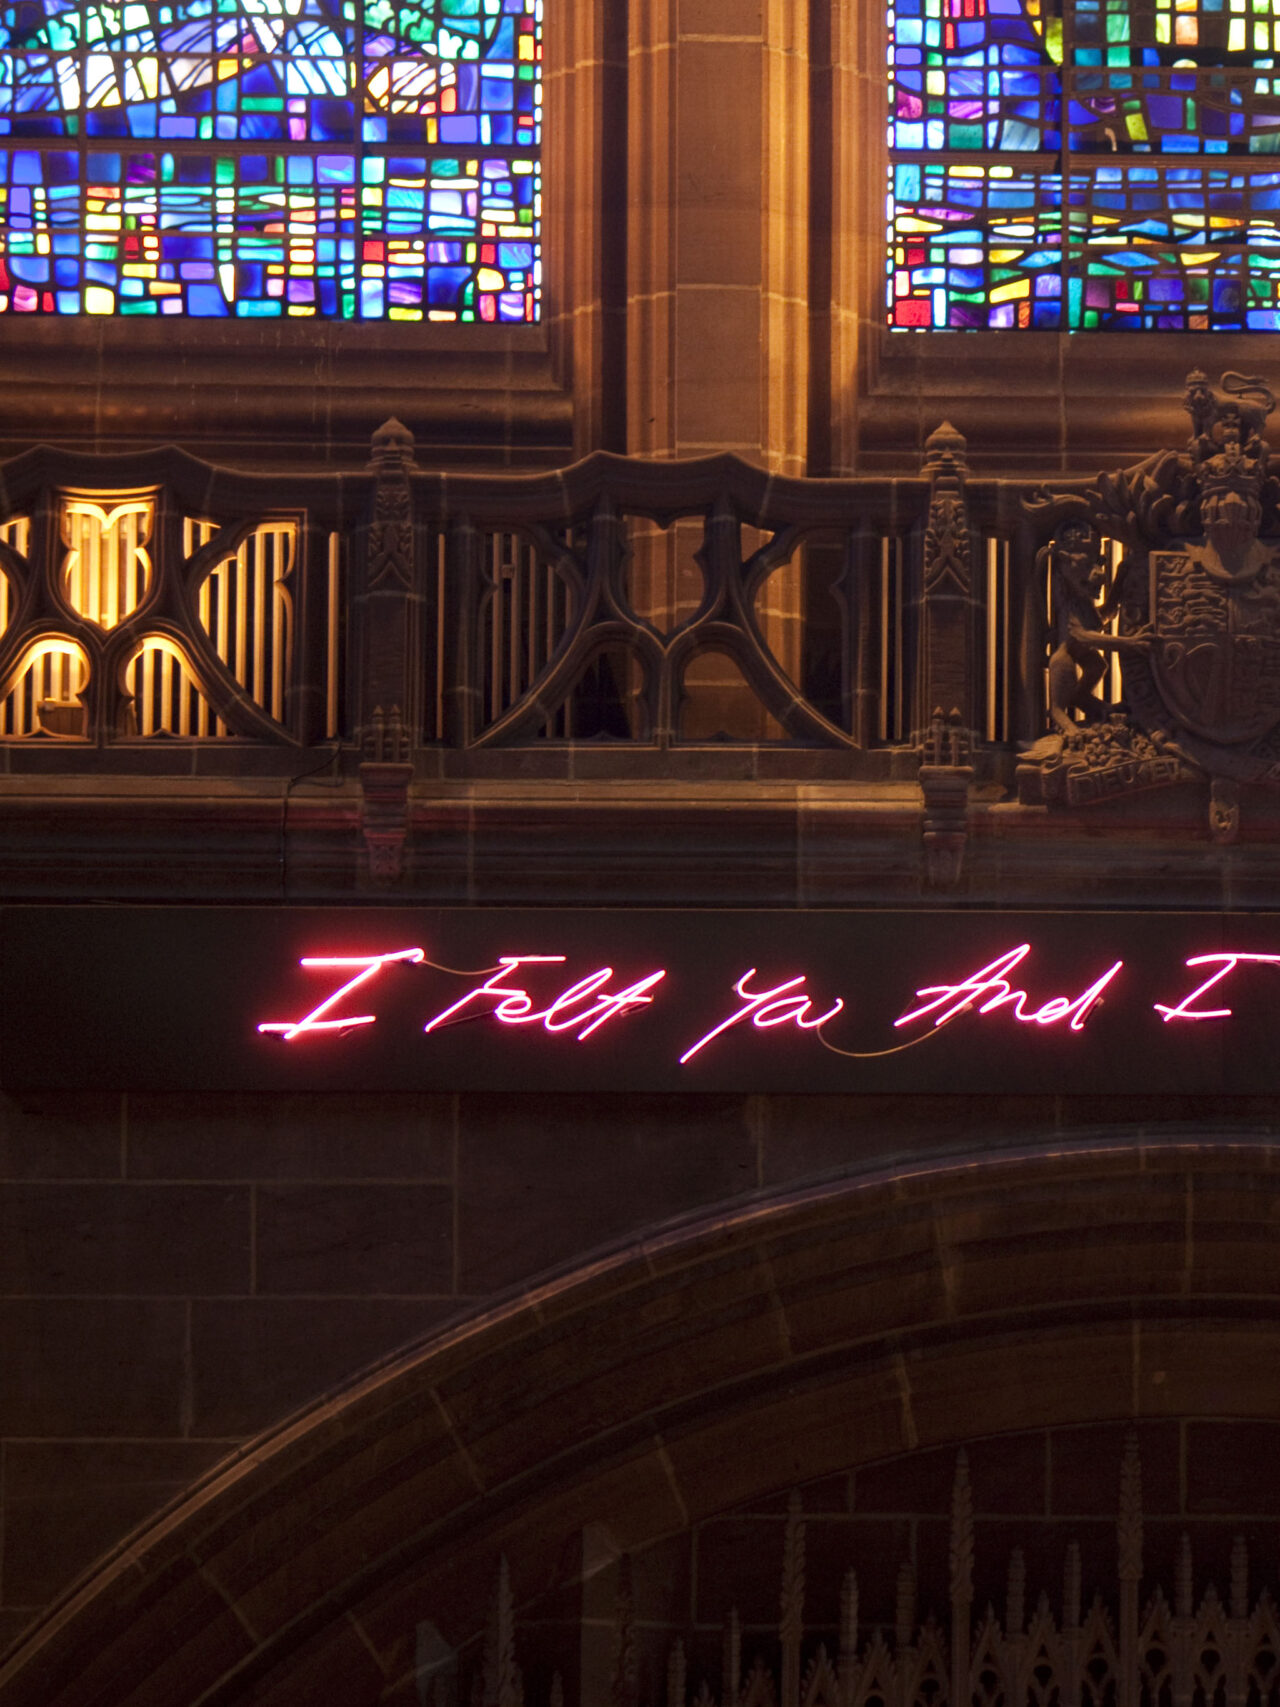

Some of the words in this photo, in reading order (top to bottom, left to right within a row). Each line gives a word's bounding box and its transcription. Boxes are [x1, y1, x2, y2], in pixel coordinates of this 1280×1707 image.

[256, 947, 425, 1040] I
[424, 956, 666, 1041] Felt
[680, 967, 843, 1064] You
[893, 943, 1123, 1030] And
